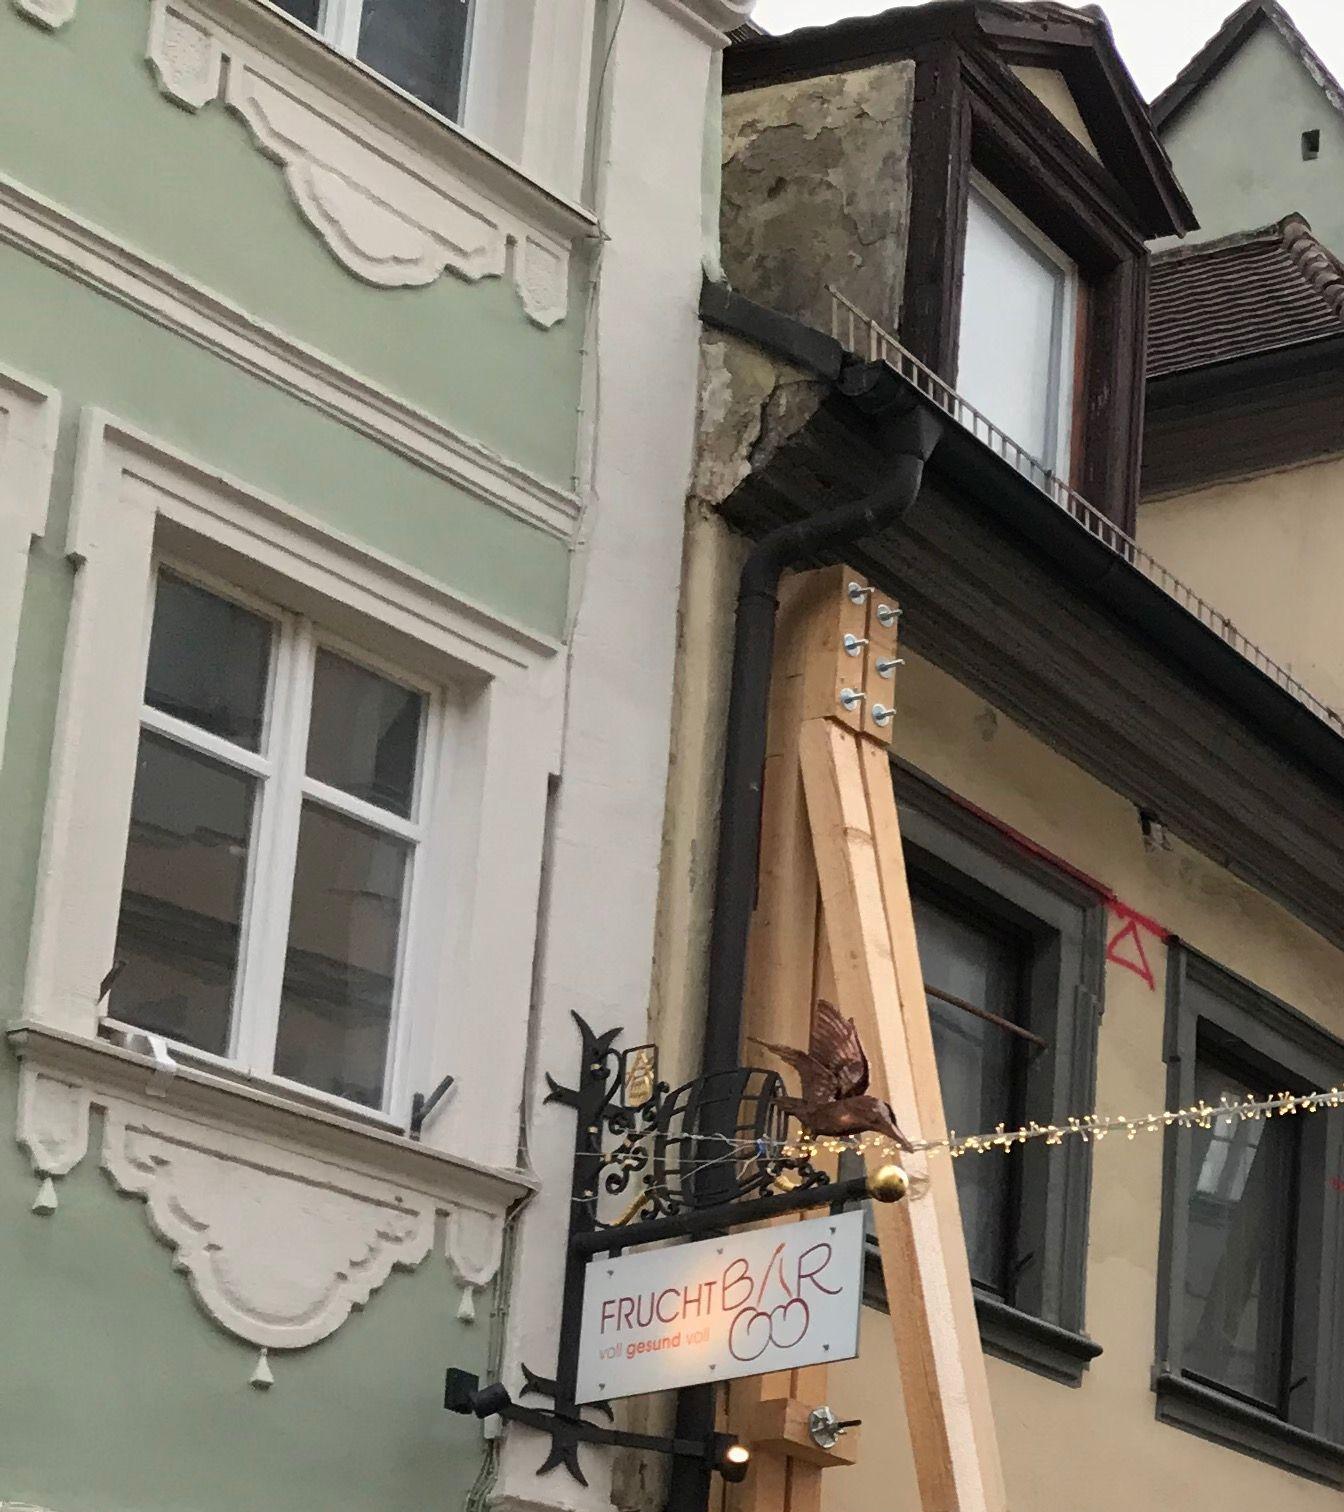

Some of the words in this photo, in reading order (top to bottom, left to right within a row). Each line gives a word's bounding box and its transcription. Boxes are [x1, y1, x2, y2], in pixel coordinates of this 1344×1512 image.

[599, 1342, 622, 1360] voll
[626, 1331, 681, 1359] gesund
[686, 1327, 711, 1346] voll
